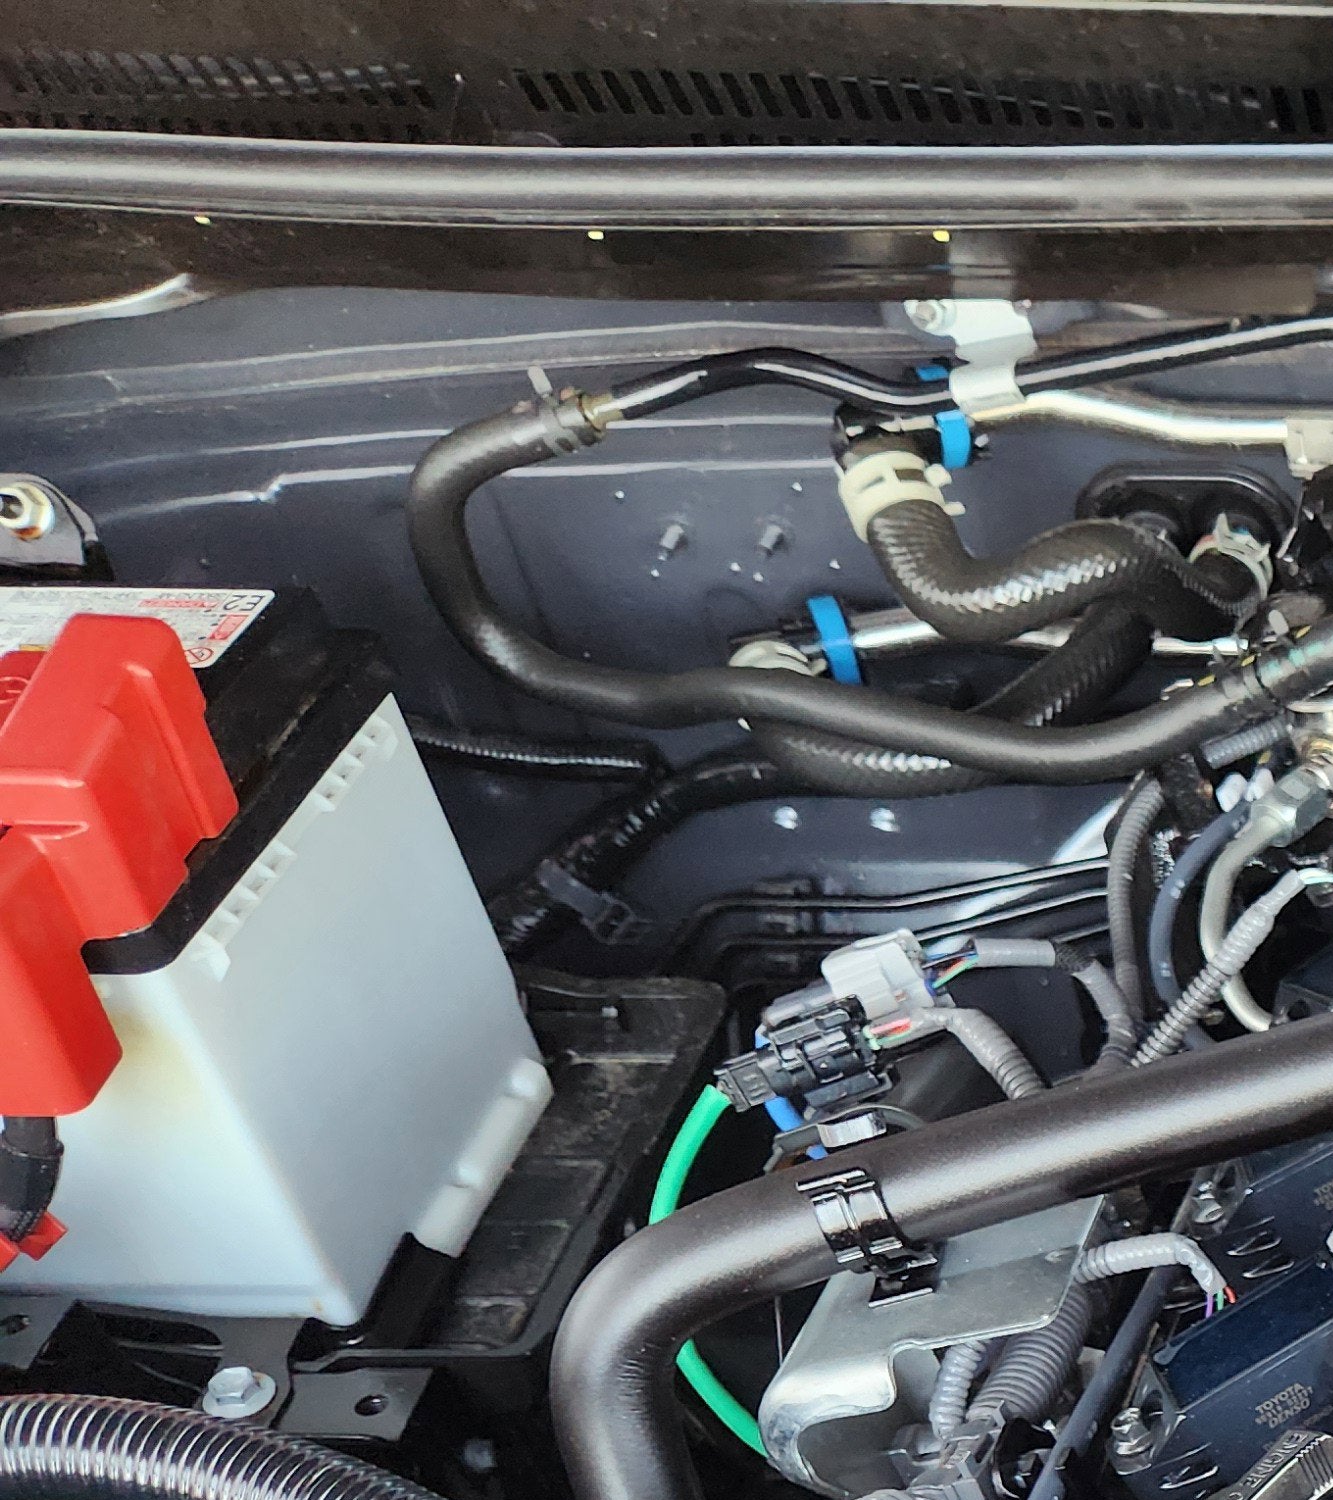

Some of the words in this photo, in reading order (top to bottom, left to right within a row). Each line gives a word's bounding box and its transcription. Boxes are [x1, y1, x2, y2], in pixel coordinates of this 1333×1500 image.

[223, 594, 265, 611] E2
[1255, 1383, 1304, 1414] TOYOTA
[1269, 1398, 1310, 1428] DENSO
[1246, 1432, 1308, 1489] ENGINE
